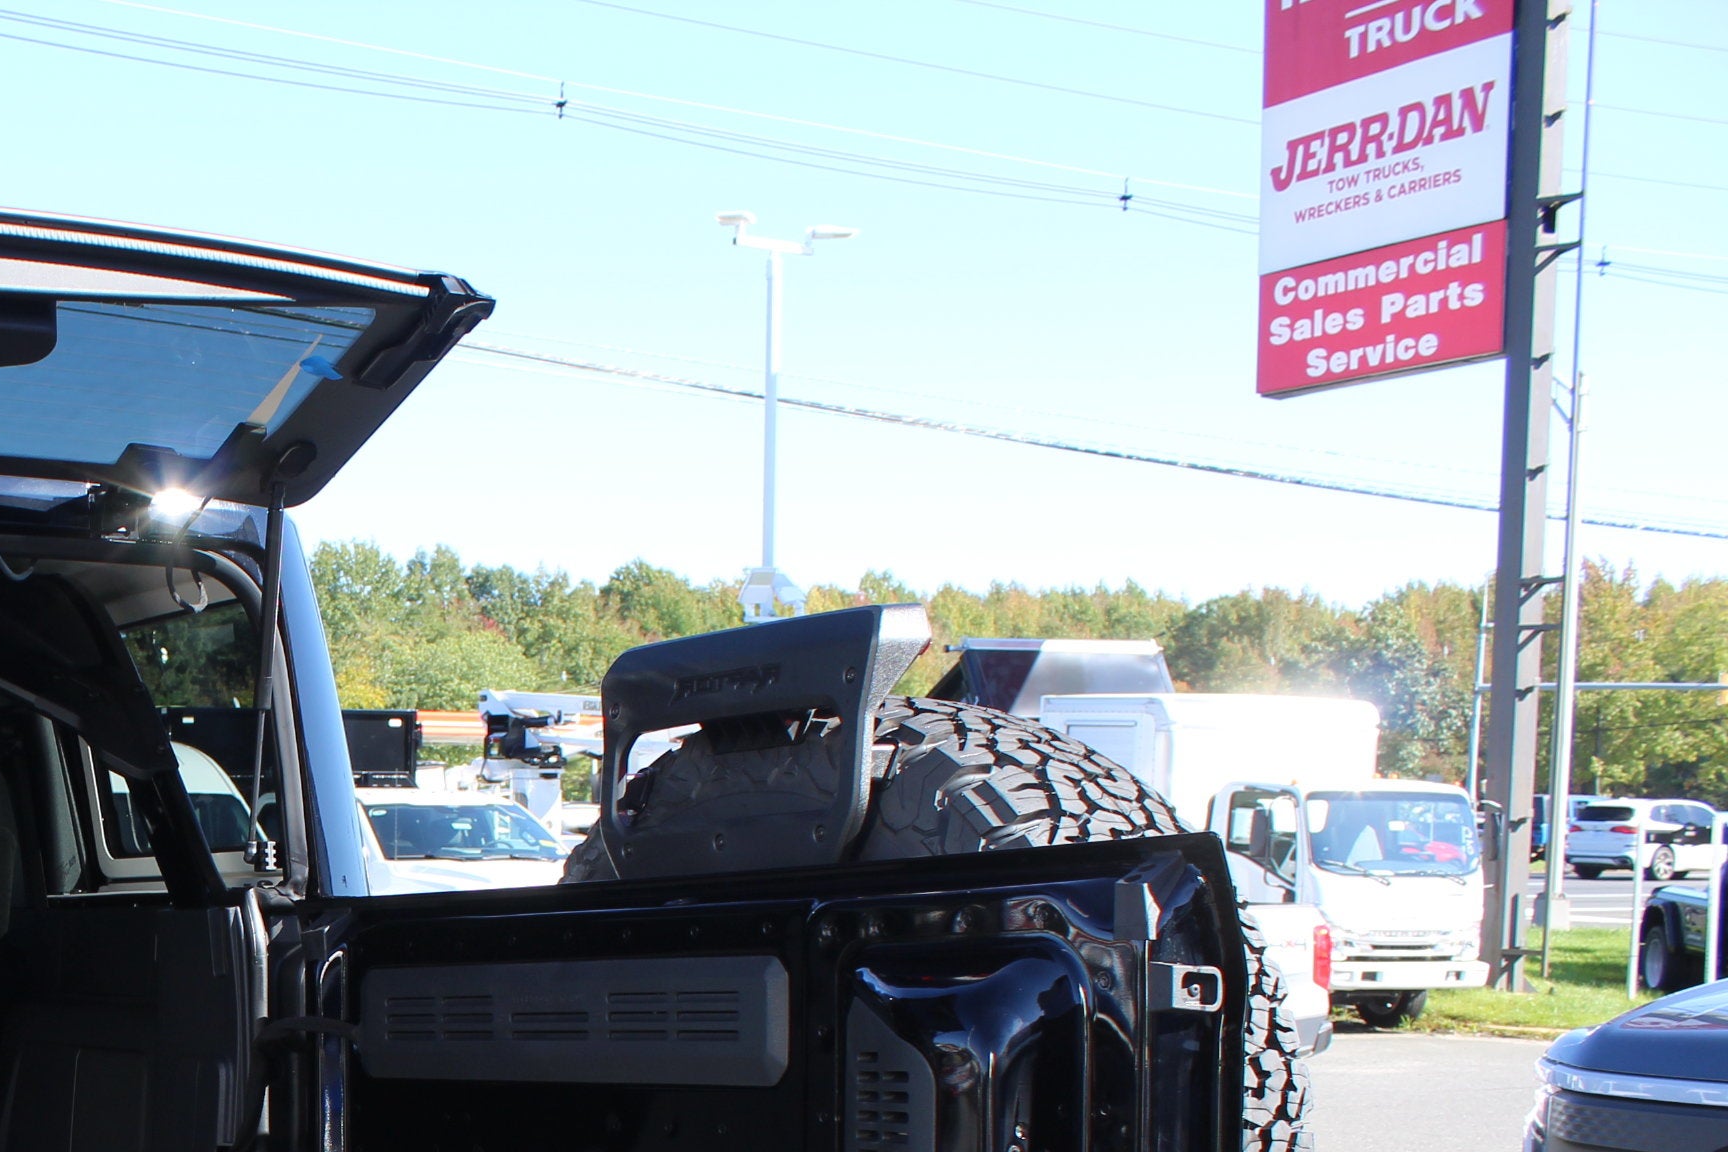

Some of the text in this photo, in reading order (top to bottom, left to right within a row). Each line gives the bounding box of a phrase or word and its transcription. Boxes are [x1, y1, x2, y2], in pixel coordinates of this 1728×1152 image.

[1344, 0, 1484, 59] TRUCK
[1294, 168, 1462, 224] WRECKERS & CARRIERS
[1327, 156, 1425, 194] TOW TRUCKS,
[1273, 233, 1484, 307] Commercial
[1269, 281, 1485, 346] Sales Parts
[1306, 333, 1439, 378] Service
